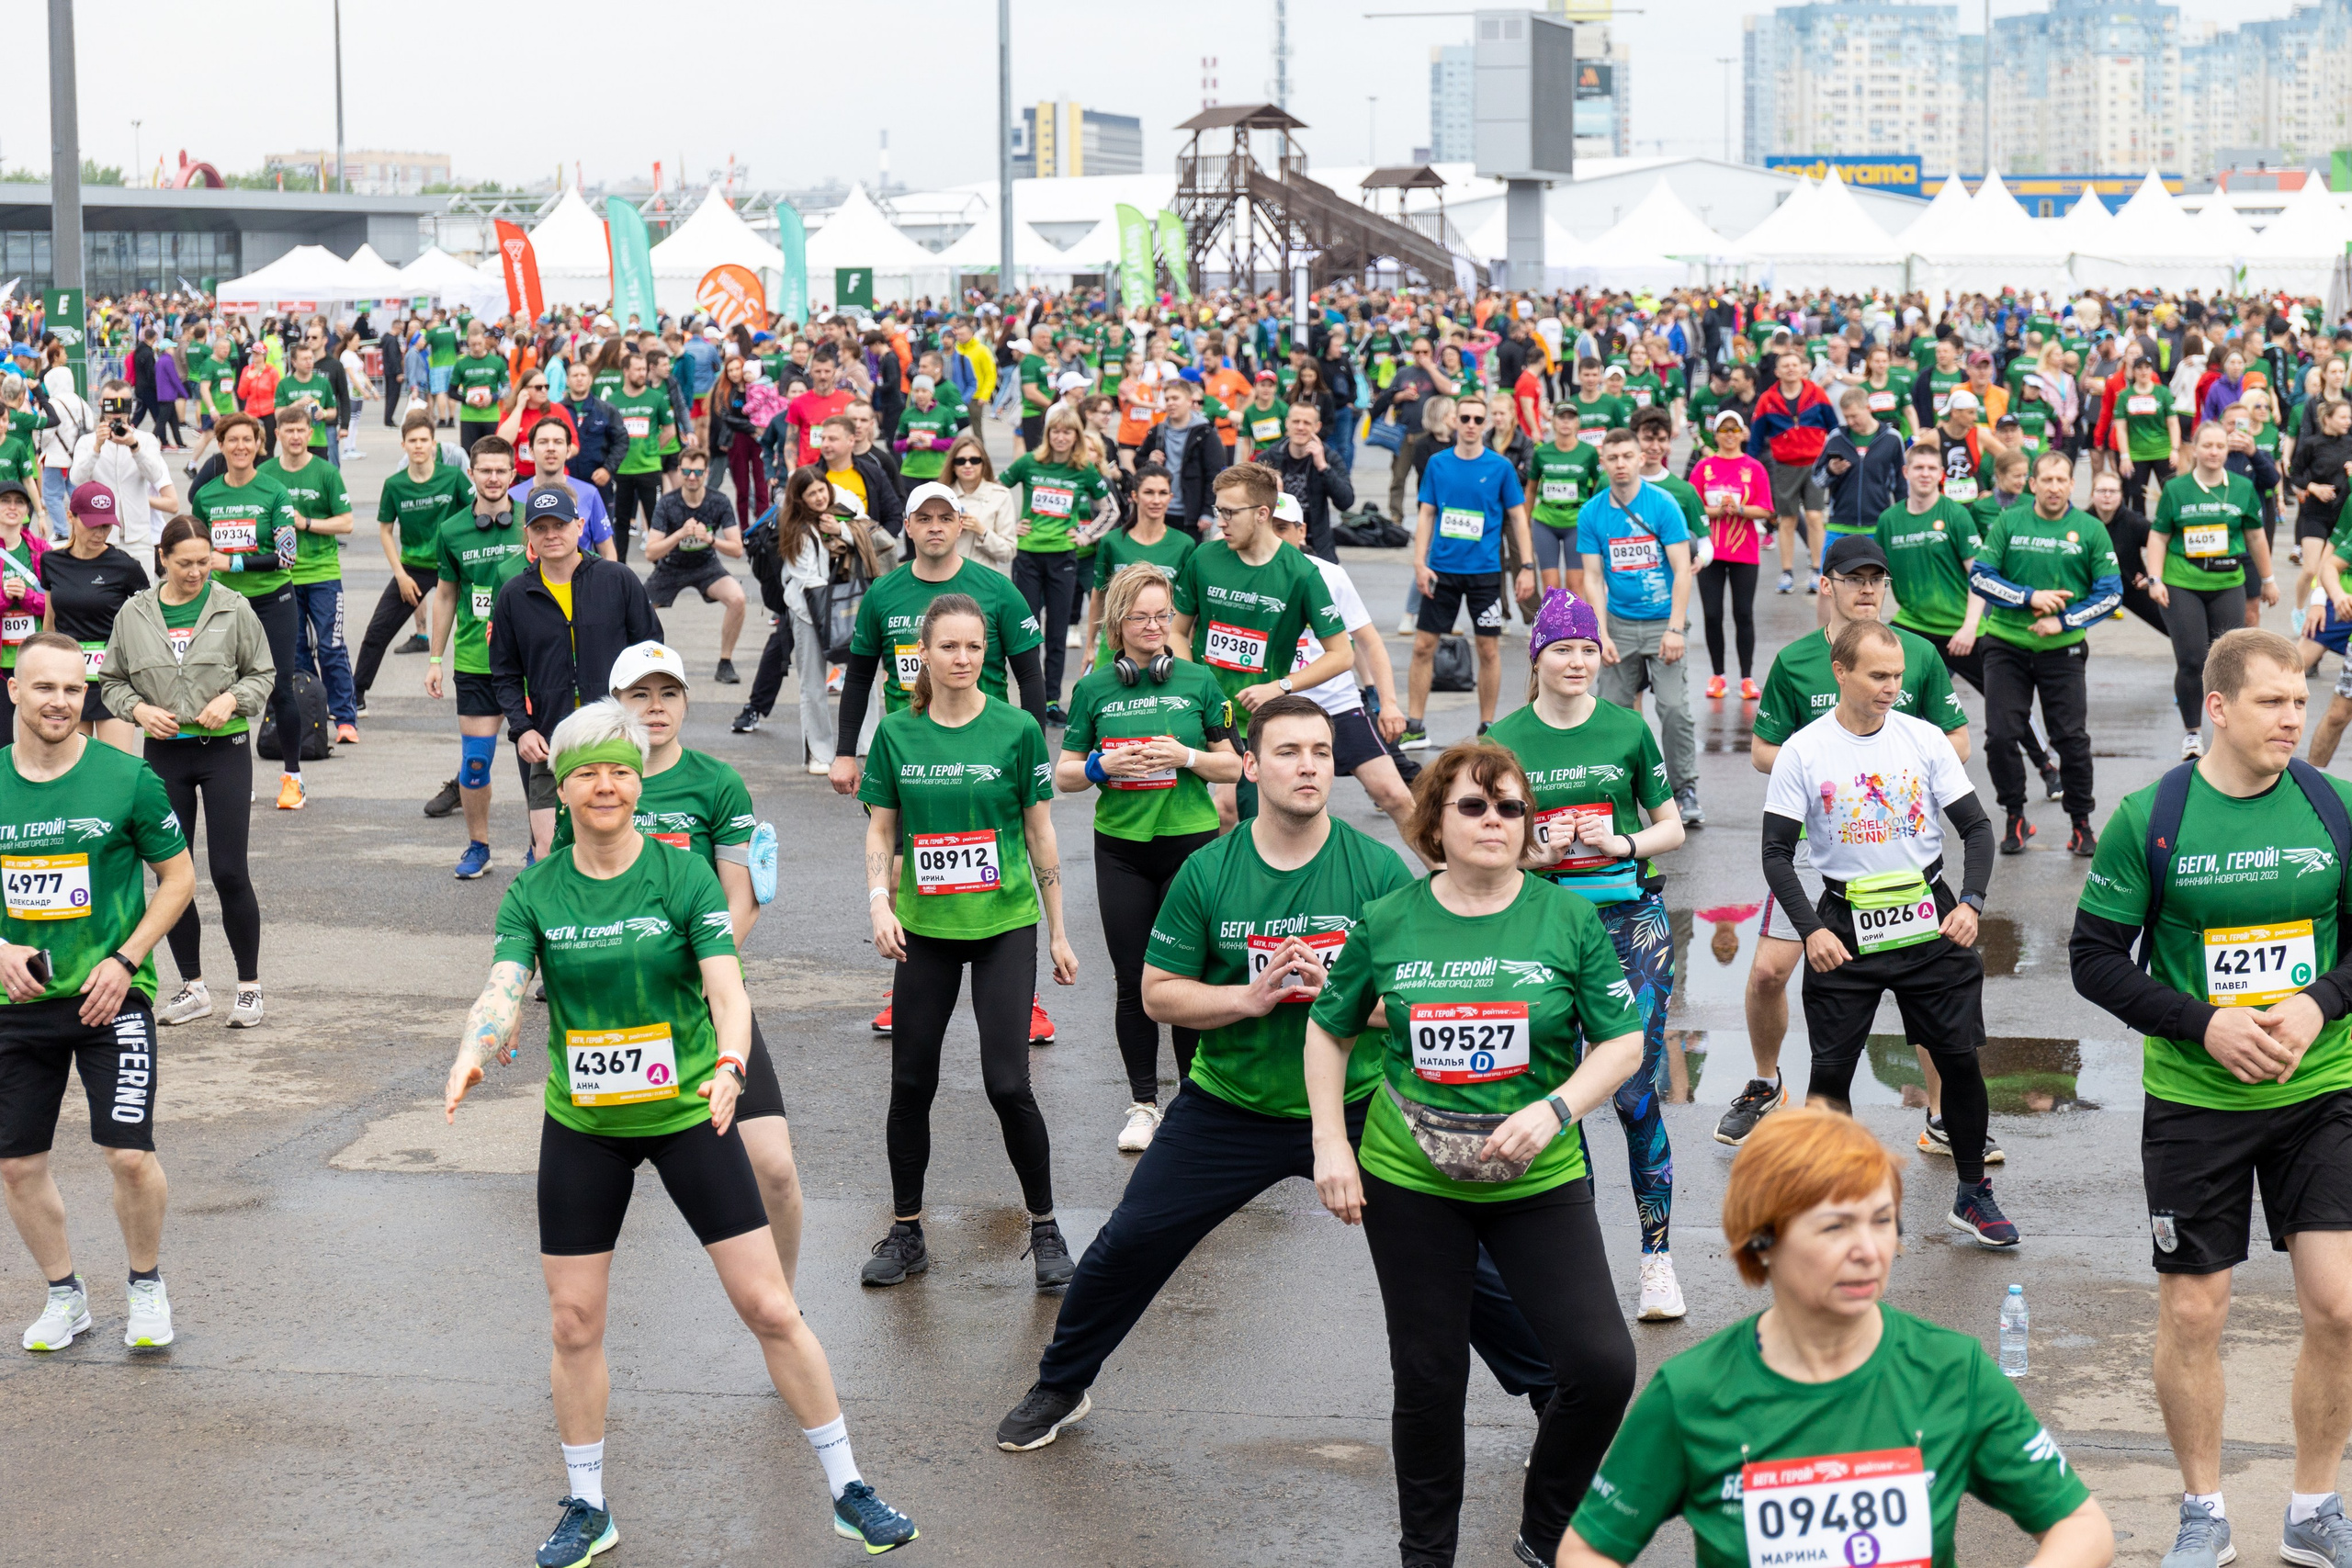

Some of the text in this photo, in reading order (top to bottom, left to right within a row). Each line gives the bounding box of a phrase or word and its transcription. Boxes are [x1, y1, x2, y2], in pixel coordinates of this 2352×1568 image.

[847, 273, 861, 294] F
[57, 294, 70, 316] E
[214, 528, 251, 540] 09334
[1613, 545, 1651, 558] 08200
[475, 596, 492, 607] 22
[1206, 585, 1260, 605] БЕГИ, ГЕРОЙ!
[5, 620, 28, 631] 809
[332, 591, 345, 648] RUSSIA
[888, 615, 911, 628] БЕГИ,
[1211, 634, 1259, 656] 09380
[900, 658, 920, 672] 30
[1243, 656, 1250, 665] C
[1128, 695, 1159, 710] ГЕРОЙ!
[900, 762, 965, 778] БЕГИ, ГЕРОЙ!
[1550, 764, 1587, 782] ГЕРОЙ!
[1543, 782, 1572, 791] НОВГОРОД
[23, 818, 66, 838] ГЕРОЙ!
[1841, 813, 1917, 832] SCHELKOVO
[1842, 824, 1917, 844] RUNNERS
[15, 839, 49, 849] НОВГОРОД
[50, 837, 64, 845] 2023
[920, 848, 989, 871] 08912
[2177, 846, 2280, 874] БЕГИ, ГЕРОЙ!
[985, 868, 996, 882] B
[2176, 871, 2278, 887] НИЖНИЙ НОВГОРОД 2023
[7, 874, 63, 894] 4977
[9, 898, 51, 907] АЛЕКСАНДР
[74, 891, 85, 905] B
[1860, 904, 1914, 931] 0026
[1921, 905, 1932, 918] A
[545, 924, 578, 942] БЕГИ,
[582, 919, 625, 939] ГЕРОЙ!
[1264, 913, 1308, 937] ГЕРОЙ!
[573, 939, 606, 950] НОВГОРОД
[607, 937, 623, 947] 2023
[1861, 931, 1884, 942] ЮРИЙ
[1219, 941, 1249, 951] НИЖНИ
[1395, 956, 1498, 981] БЕГИ, ГЕРОЙ!
[2214, 945, 2287, 975] 4217
[2296, 966, 2307, 983] C
[1427, 979, 1473, 989] НОВГОРОД
[1474, 978, 1494, 987] 2023
[2215, 981, 2247, 990] ПАВЕЛ
[1417, 1009, 1456, 1019] БЕГИ, ГЕРОЙ!
[571, 1034, 605, 1046] БЕГИ, ГЕРОЙ!
[1419, 1025, 1515, 1052] 09527
[574, 1048, 642, 1076] 4367
[1419, 1057, 1464, 1066] НАТАЛЬЯ
[1476, 1054, 1489, 1071] D
[650, 1066, 665, 1084] A
[576, 1082, 600, 1090] АННА
[1752, 1466, 1814, 1487] БЕГИ, ГЕРОЙ!
[1721, 1473, 1744, 1501] БЕ
[1758, 1488, 1908, 1540] 09480
[1760, 1547, 1828, 1566] МАРИНА
[1850, 1536, 1875, 1566] B
